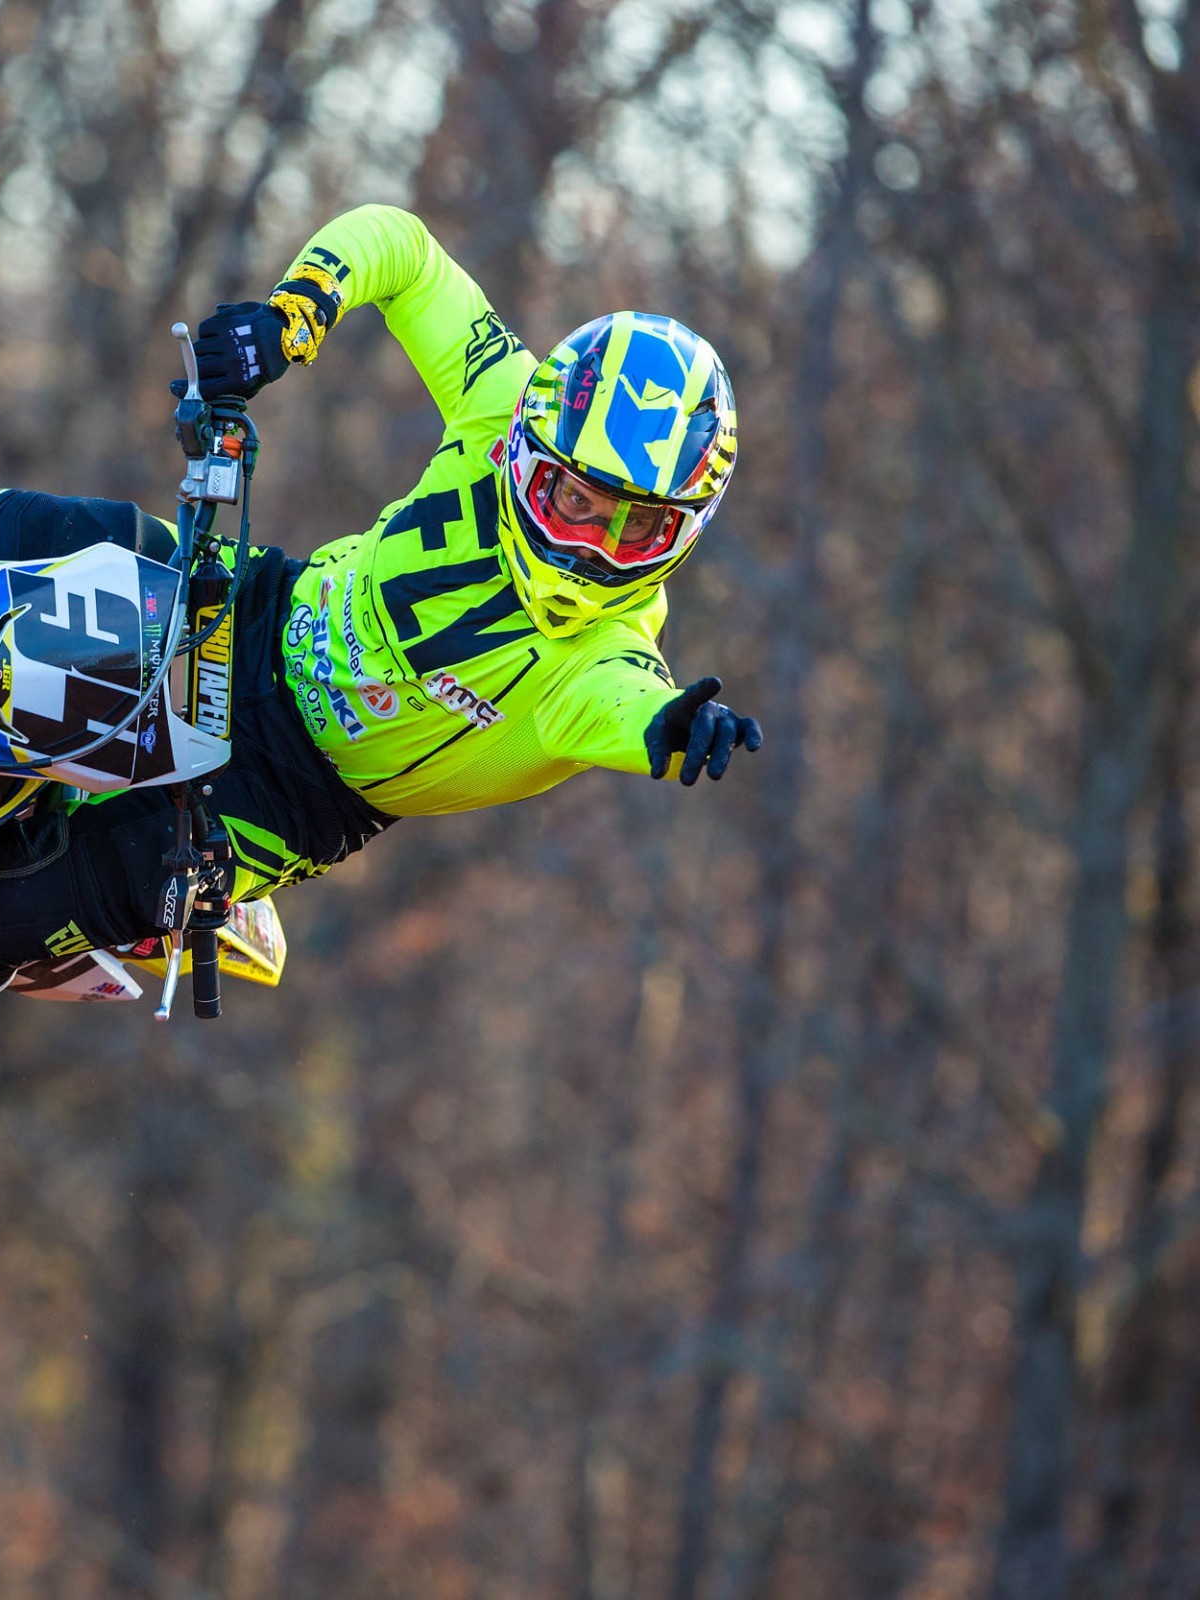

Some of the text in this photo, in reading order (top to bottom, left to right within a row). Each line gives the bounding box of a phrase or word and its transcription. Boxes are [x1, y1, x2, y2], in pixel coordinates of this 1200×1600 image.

[1, 658, 13, 691] JGR
[433, 672, 500, 725] KMC
[163, 877, 178, 928] ARC
[44, 919, 95, 957] FLY
